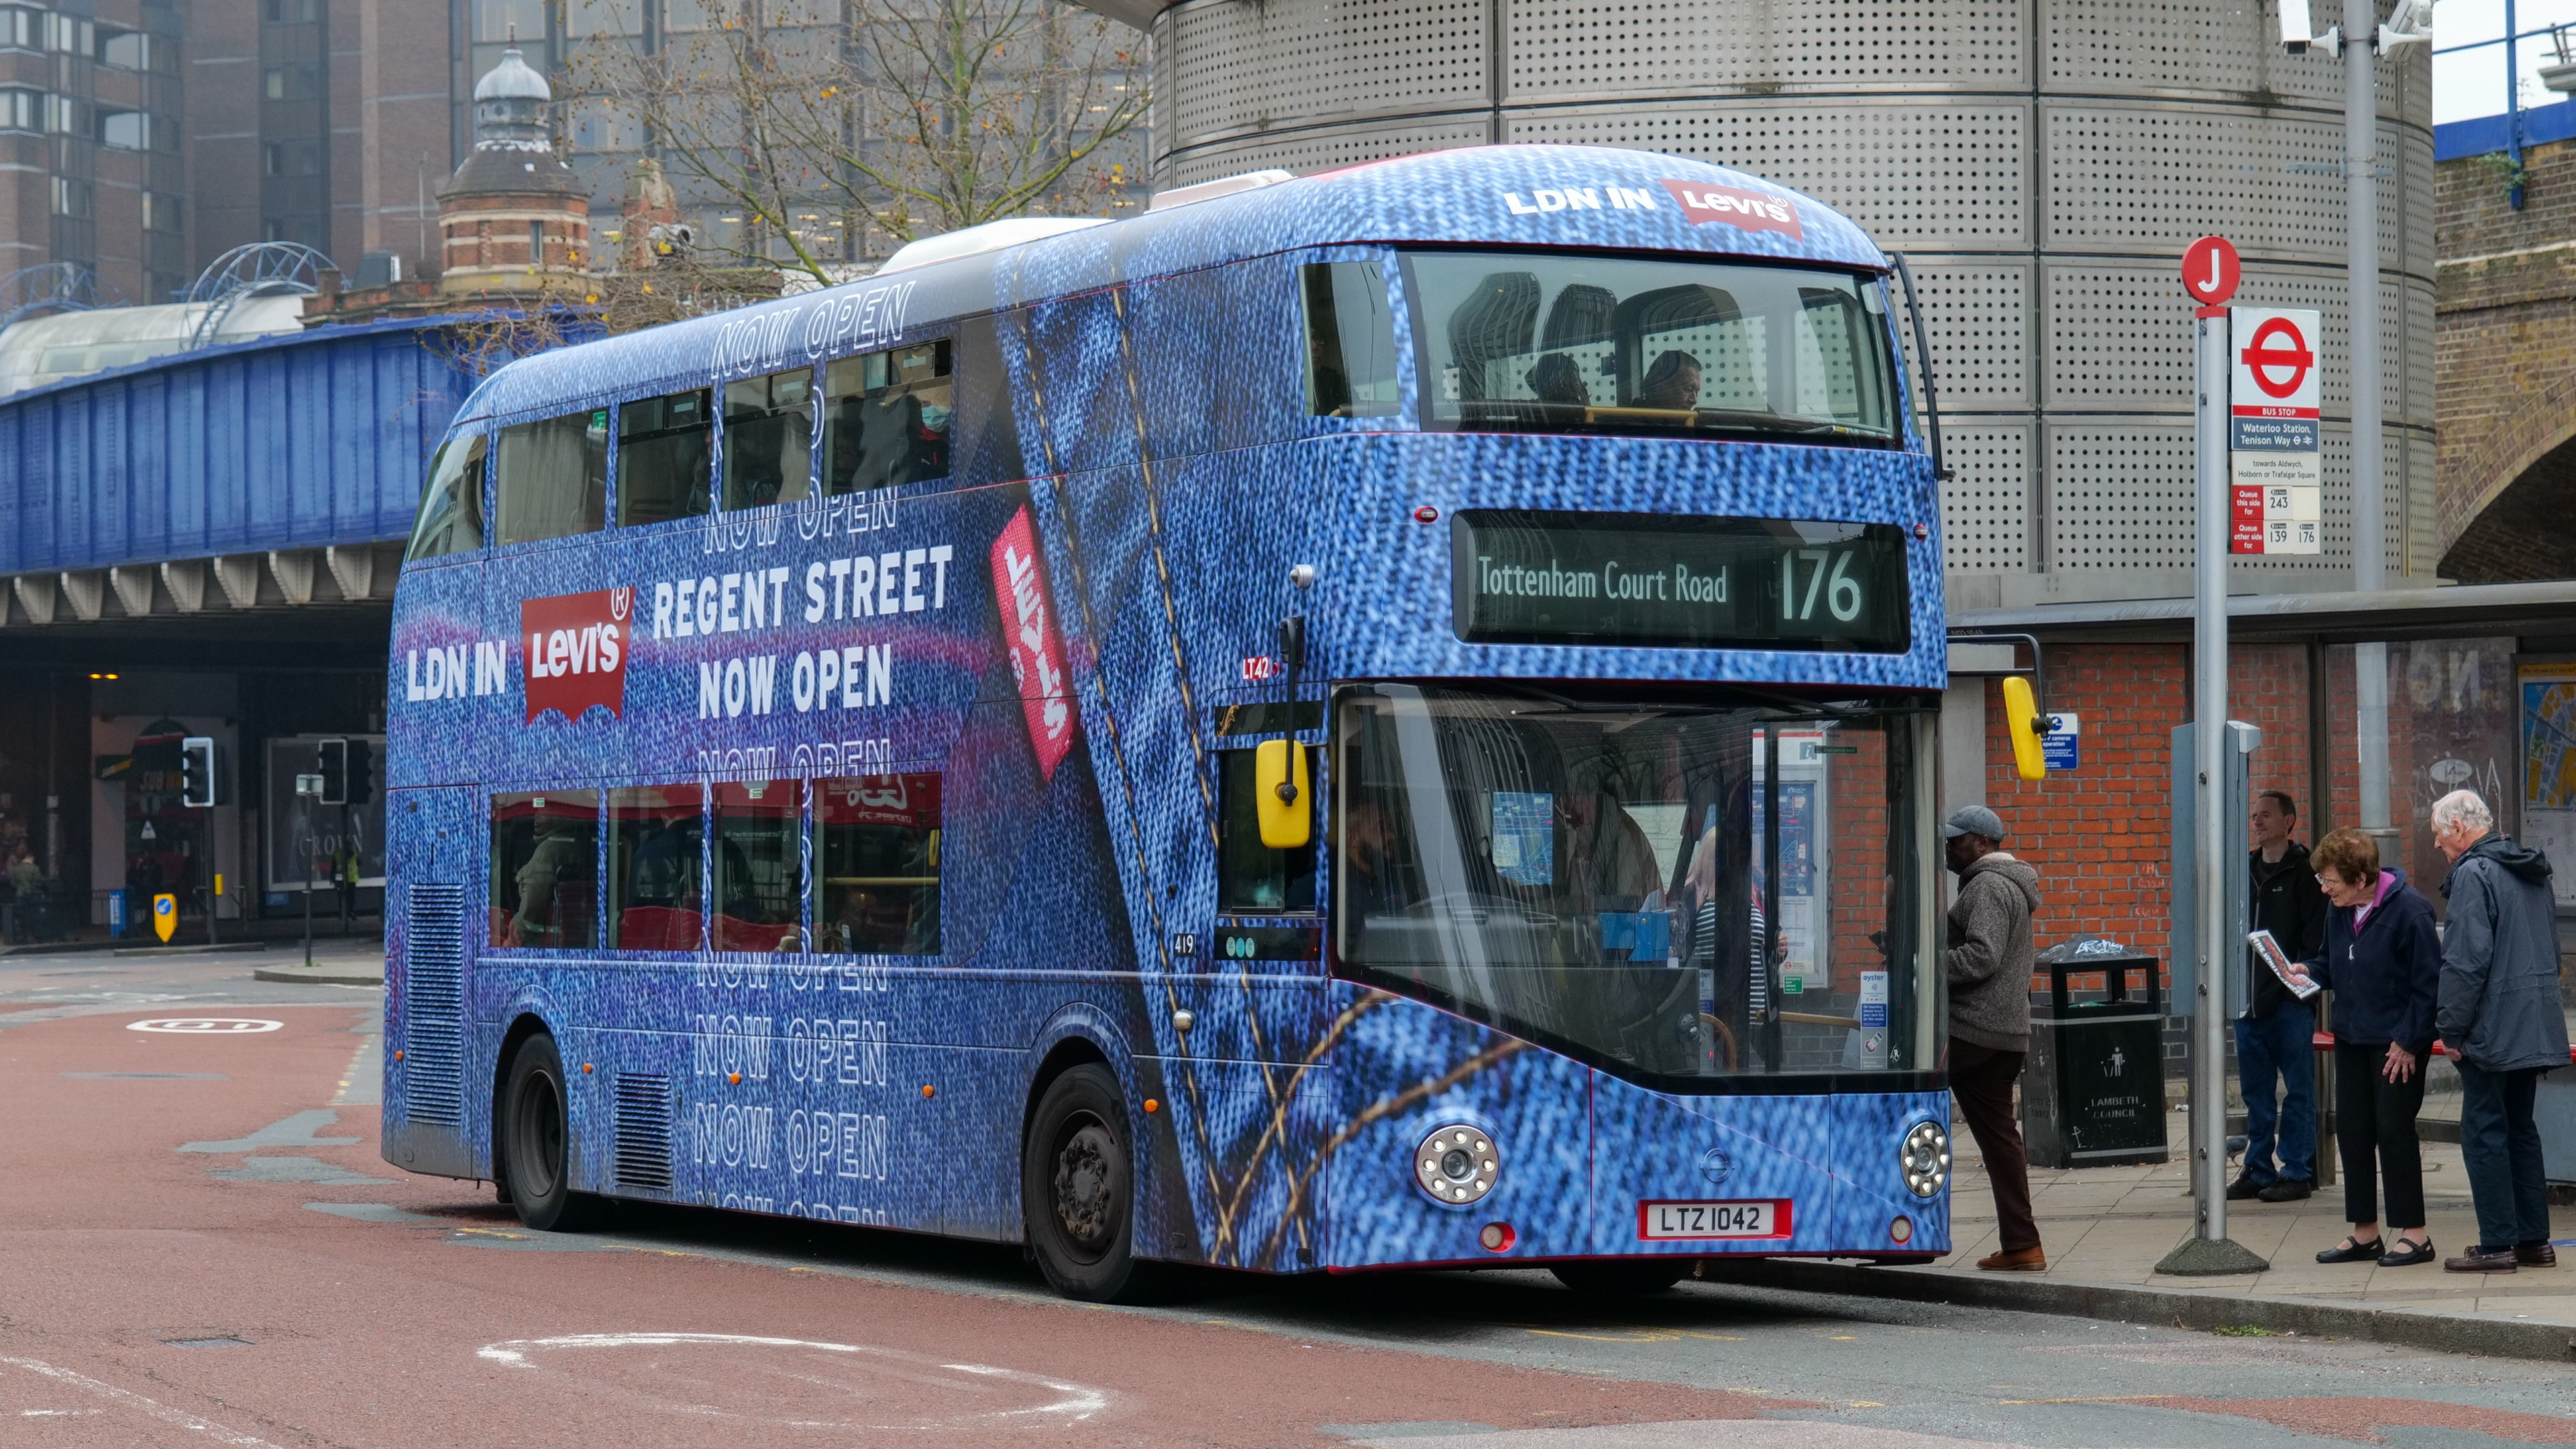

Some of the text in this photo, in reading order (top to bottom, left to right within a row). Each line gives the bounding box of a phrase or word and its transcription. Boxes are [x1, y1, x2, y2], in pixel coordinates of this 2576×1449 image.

[1503, 187, 1601, 215] LDN
[1605, 187, 1656, 210] IN
[2197, 248, 2220, 293] J
[710, 280, 918, 380] NOW OPEN
[2262, 407, 2296, 416] BUS STOP
[2242, 423, 2312, 434] Waterloo Station,
[2240, 435, 2292, 447] Tenison Way
[2277, 460, 2303, 469] Aldwych,
[2271, 471, 2296, 480] Trafalgar
[2297, 471, 2316, 480] Square
[2239, 490, 2258, 498] Queue
[2269, 497, 2288, 508] 243
[2270, 531, 2314, 543] 139 176
[653, 545, 953, 639] REGENT STREET
[1478, 548, 1862, 622] Tottenham Court Road 176
[407, 643, 467, 702] LDN
[474, 639, 506, 696] IN
[1242, 657, 1269, 680] LT42
[699, 643, 892, 720] NOW OPEN
[1175, 934, 1194, 954] 419
[1863, 974, 1884, 982] oyster
[695, 1014, 887, 1086] NOW OPEN
[2091, 1095, 2139, 1107] LAMBETH
[2092, 1108, 2136, 1120] COUNCIL
[694, 1102, 886, 1181] NOW OPEN
[1660, 1206, 1760, 1232] LTZ 1042
